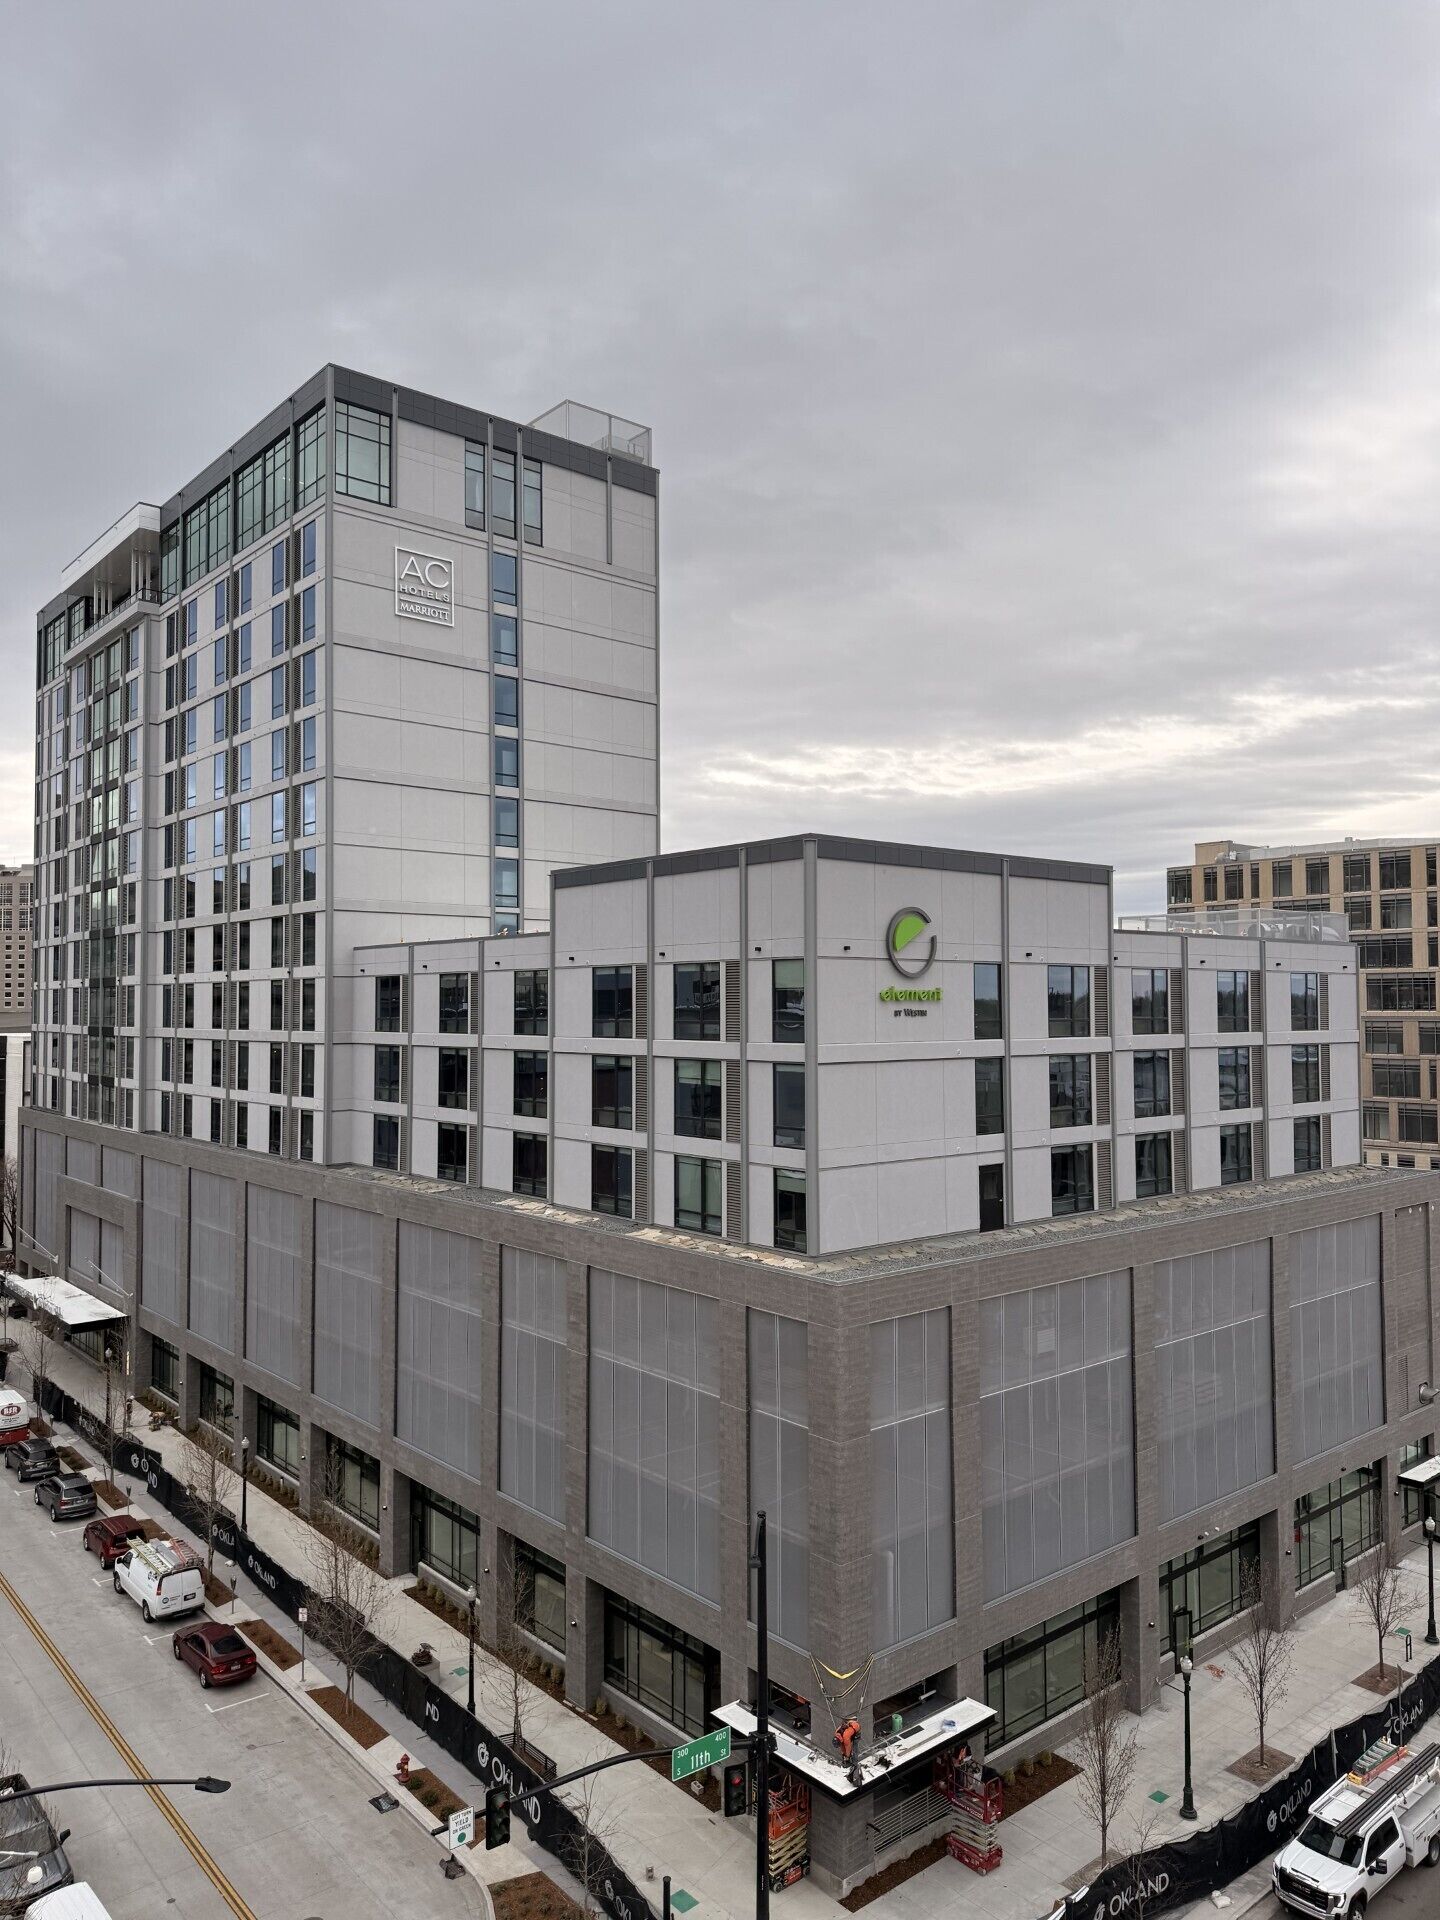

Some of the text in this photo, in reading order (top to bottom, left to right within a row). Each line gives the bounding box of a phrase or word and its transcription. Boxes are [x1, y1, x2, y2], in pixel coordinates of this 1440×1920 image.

[400, 556, 449, 588] AC
[400, 584, 449, 602] HOTELS
[400, 602, 449, 620] MARRIOTT
[880, 986, 943, 1002] element
[3, 1406, 18, 1415] BSR
[254, 1561, 276, 1589] OKLAND
[425, 1700, 440, 1722] ND
[677, 1731, 727, 1758] 300 400
[690, 1750, 711, 1770] 11th
[720, 1748, 726, 1756] St
[1280, 1778, 1312, 1823] OKLAND
[1109, 1872, 1170, 1916] OKLAND
